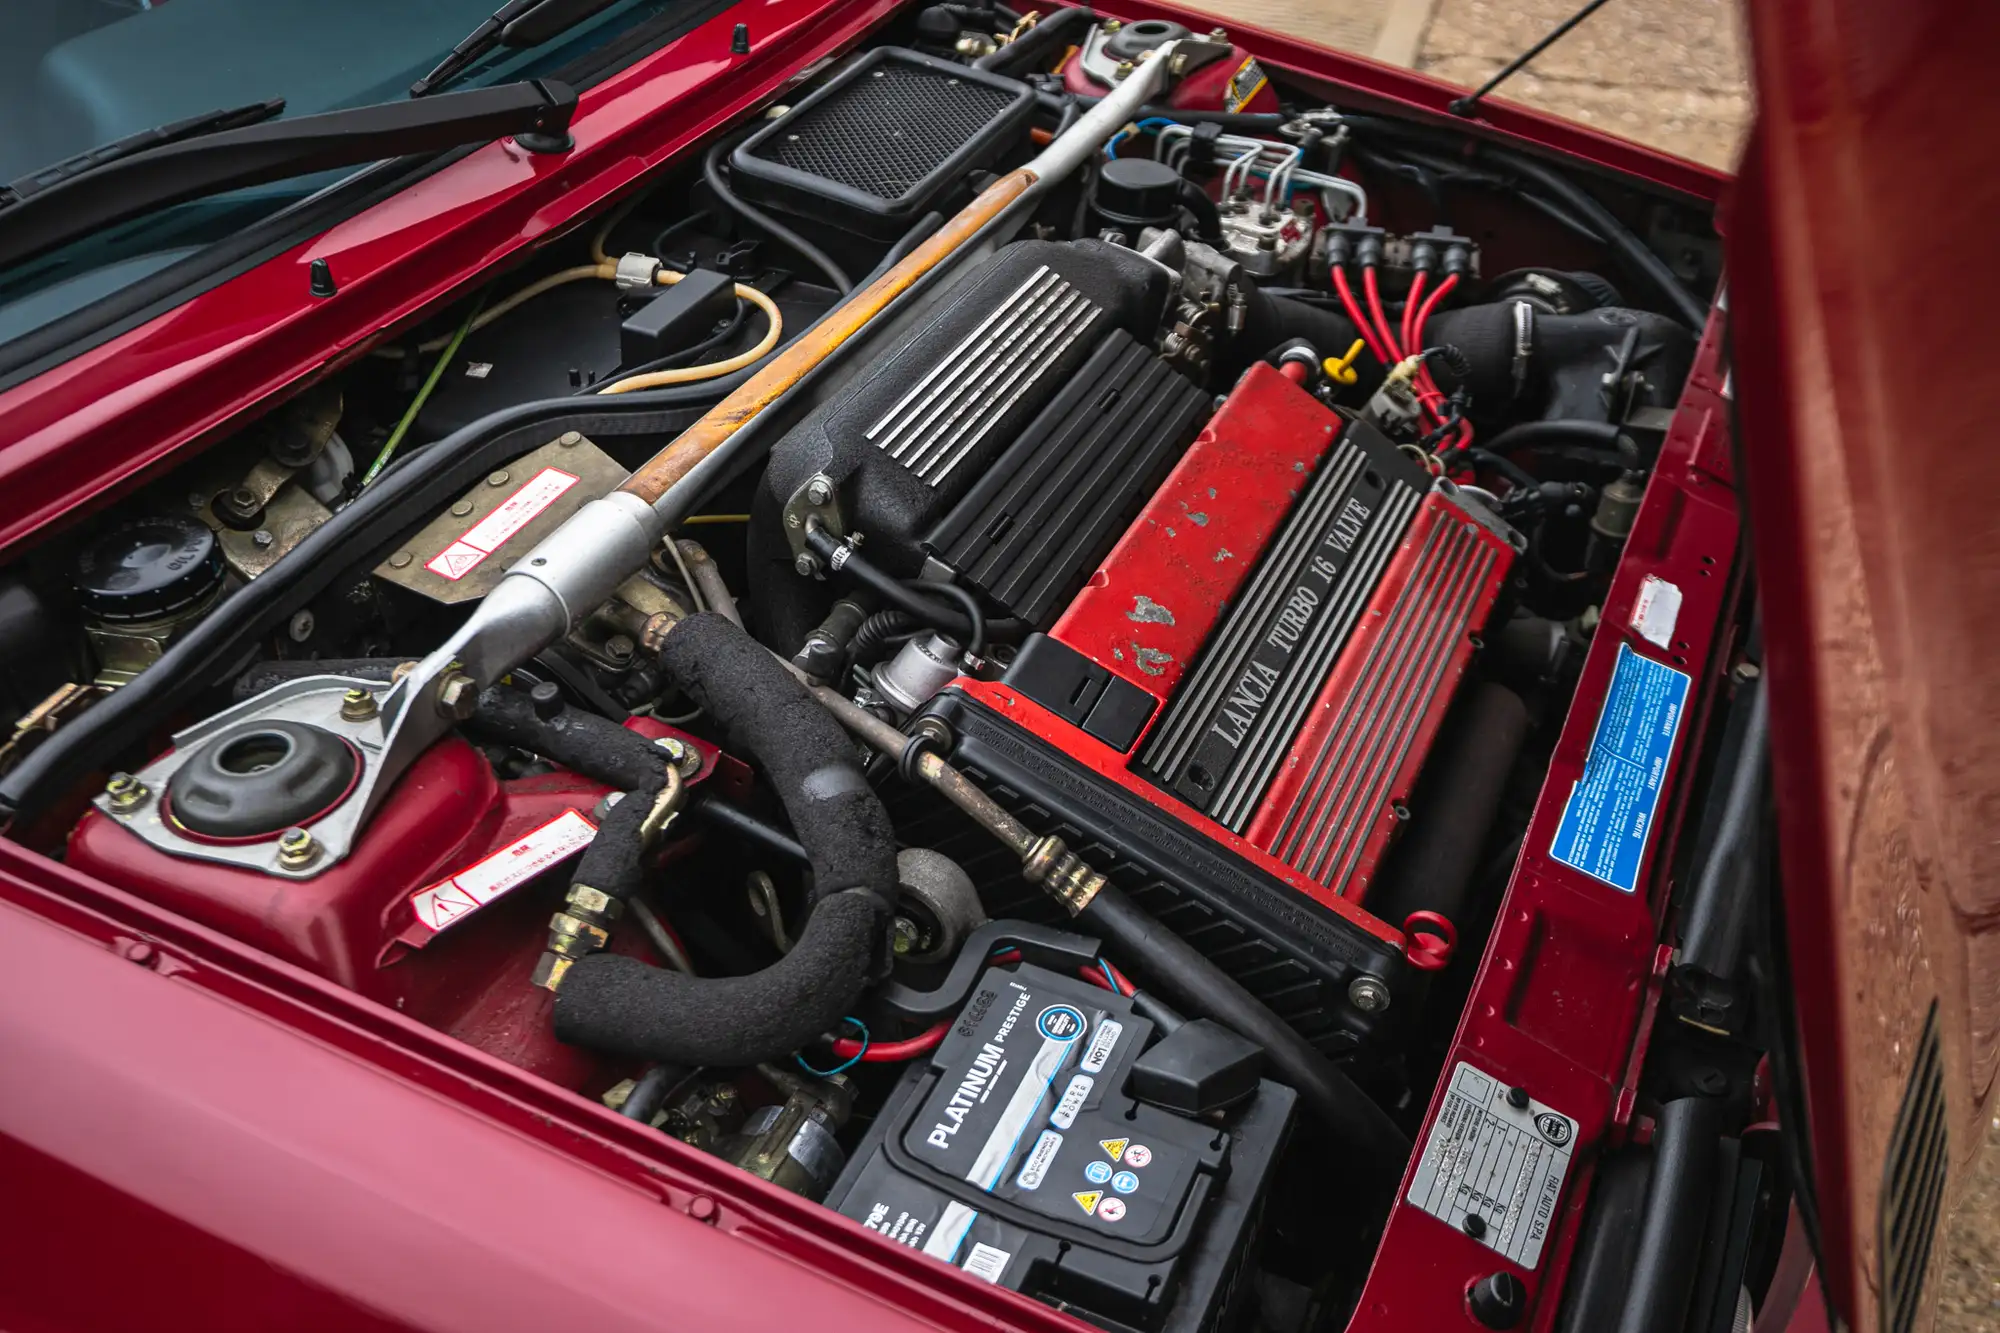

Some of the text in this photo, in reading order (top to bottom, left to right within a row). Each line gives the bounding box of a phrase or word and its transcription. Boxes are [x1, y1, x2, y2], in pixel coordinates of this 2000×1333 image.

[1211, 497, 1371, 749] LANCIA TURBO 16 VALVE
[1661, 702, 1677, 737] IMPORTANTE
[1647, 756, 1663, 791] IMPORTANT
[1632, 811, 1647, 839] WICHTIG
[928, 993, 1030, 1148] PLATINUM PRESTIGE
[1058, 1084, 1080, 1115] EXTRA
[1064, 1085, 1086, 1118] POWER
[1030, 1137, 1049, 1171] ECO FRIENDLY
[1458, 1183, 1473, 1196] Kg
[1469, 1188, 1483, 1202] Kg
[1480, 1195, 1495, 1208] Kg
[1492, 1201, 1506, 1215] Kg
[1530, 1175, 1559, 1240] FIAT AUTO S.P.A.
